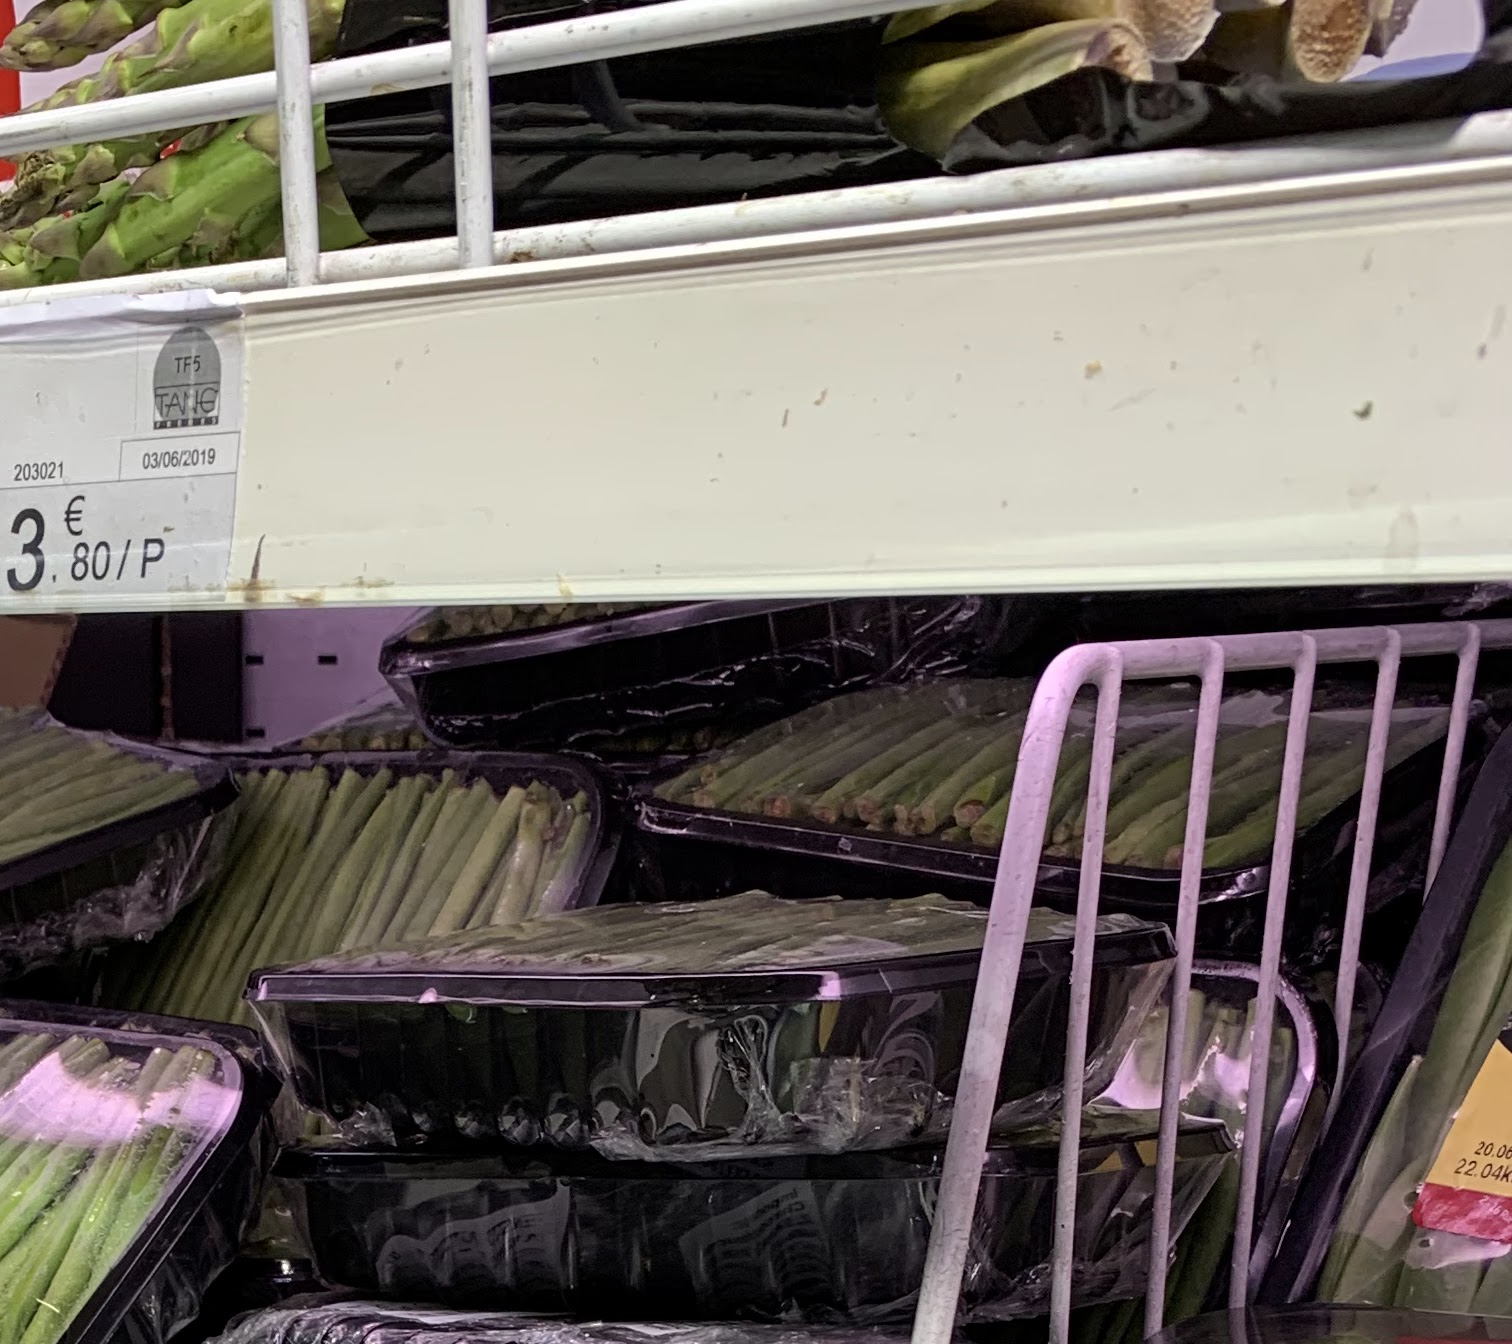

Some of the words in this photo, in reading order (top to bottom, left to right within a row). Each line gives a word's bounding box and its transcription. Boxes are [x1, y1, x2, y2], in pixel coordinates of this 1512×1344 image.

[174, 355, 201, 373] TF5
[142, 448, 216, 469] 03/06/2019
[13, 461, 64, 481] 203021
